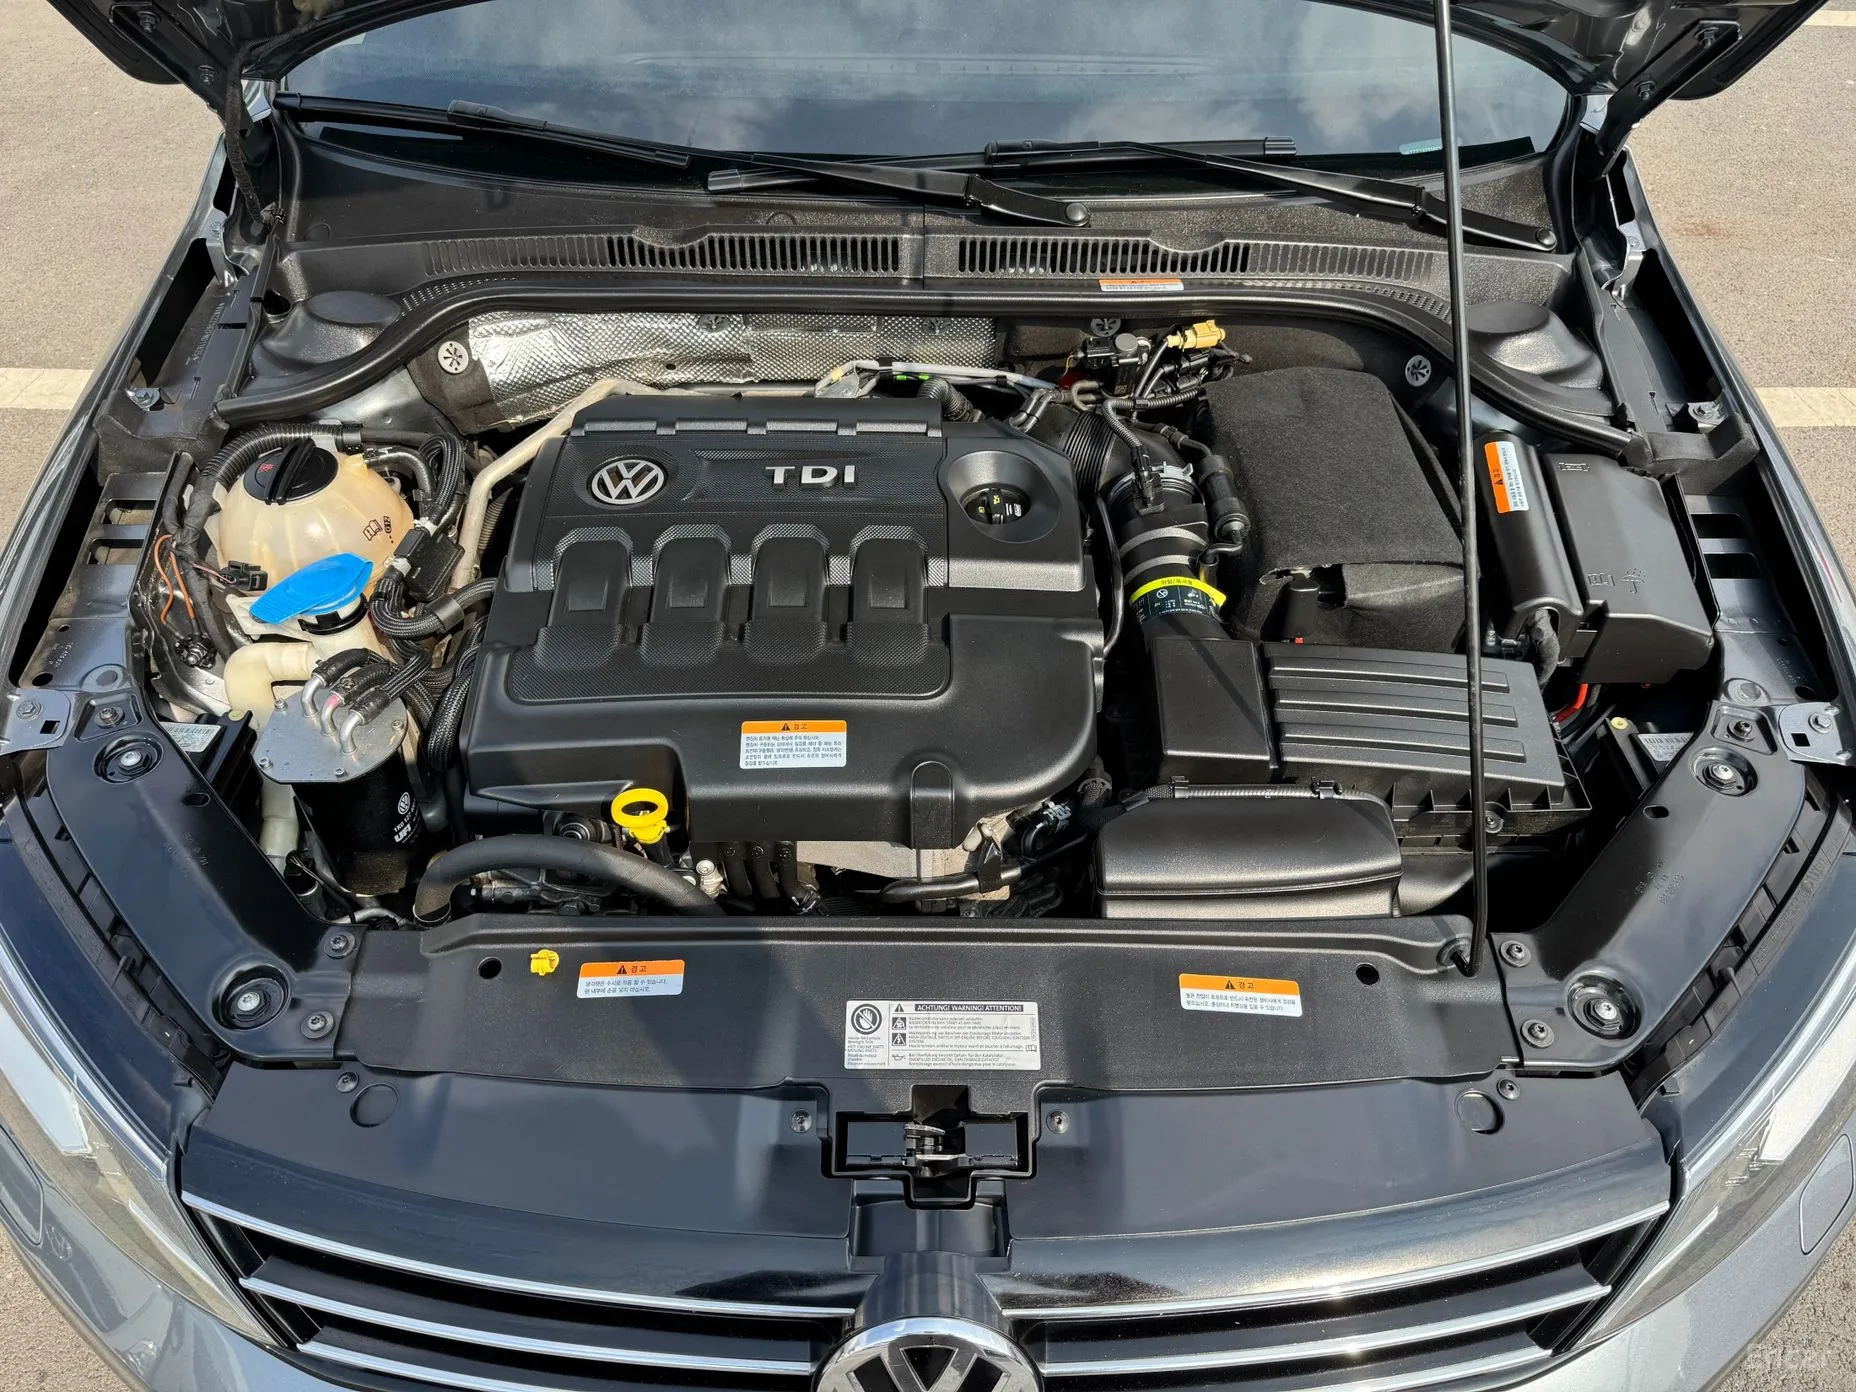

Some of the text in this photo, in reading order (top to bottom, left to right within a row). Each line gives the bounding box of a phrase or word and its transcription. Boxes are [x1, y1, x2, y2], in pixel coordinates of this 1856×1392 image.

[765, 465, 856, 487] TDI
[394, 823, 412, 842] UFI
[632, 966, 646, 974] 경고
[1238, 982, 1254, 990] 경고
